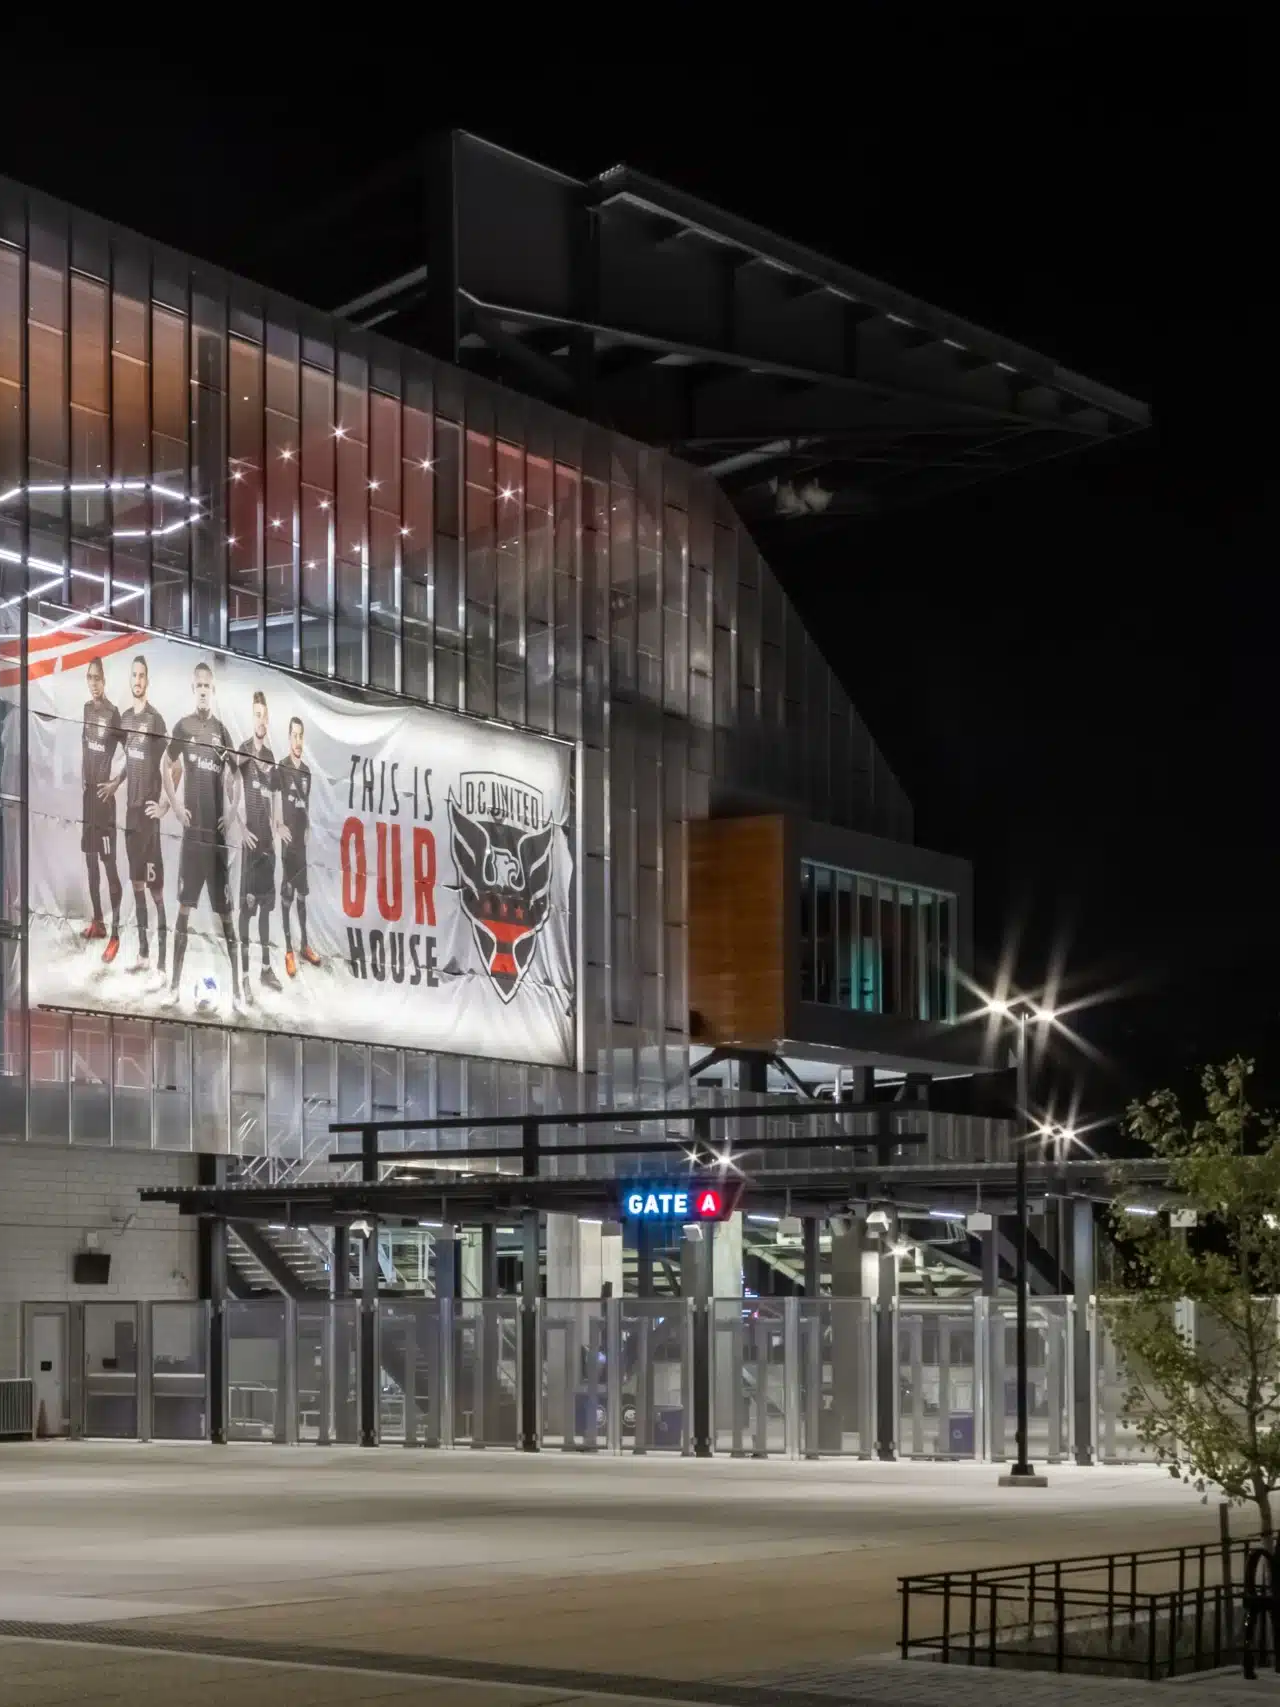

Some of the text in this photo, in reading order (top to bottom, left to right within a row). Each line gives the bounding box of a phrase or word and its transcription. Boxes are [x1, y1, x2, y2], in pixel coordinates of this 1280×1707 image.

[348, 754, 433, 821] THIS IS
[340, 815, 437, 926] OUR
[347, 927, 439, 988] HOUSE
[628, 1193, 716, 1214] GATE A
